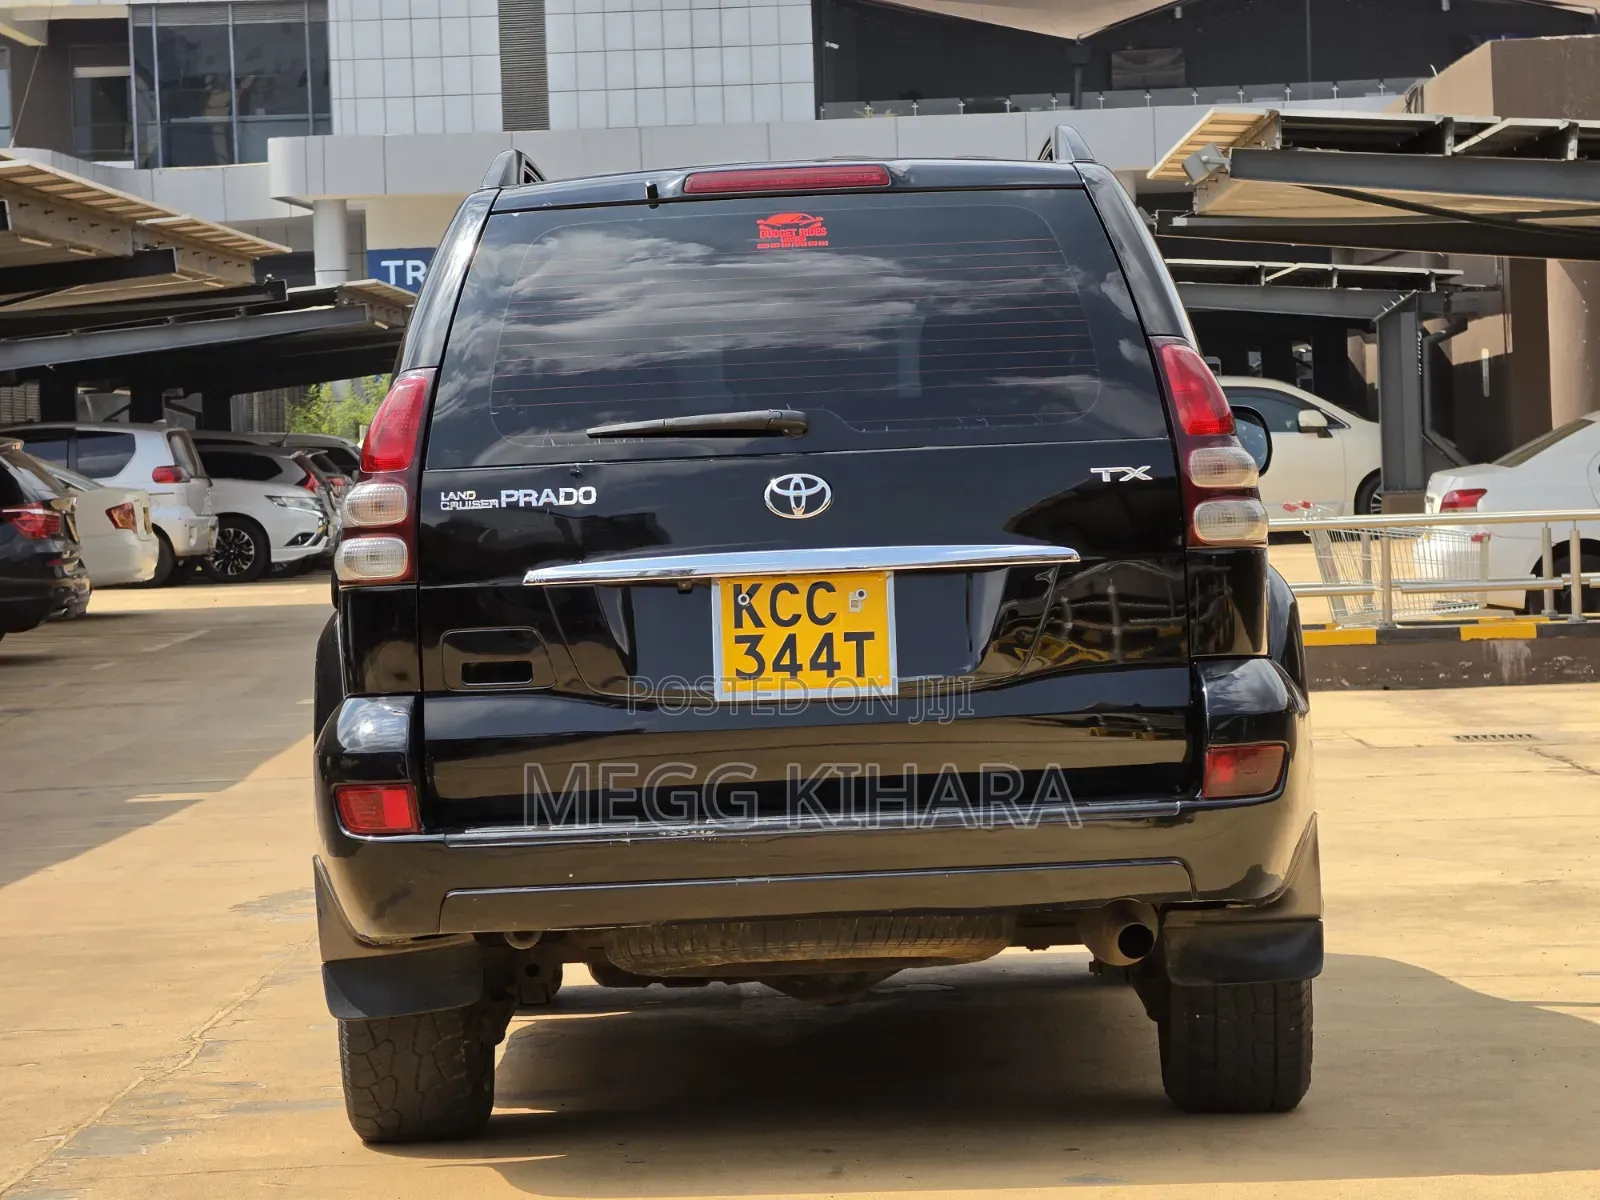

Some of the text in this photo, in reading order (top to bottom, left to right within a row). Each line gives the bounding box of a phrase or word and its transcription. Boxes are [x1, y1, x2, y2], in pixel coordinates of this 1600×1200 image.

[760, 227, 827, 239] BUDGET RIDES
[1090, 465, 1154, 483] TX
[440, 490, 477, 501] LAND
[500, 486, 598, 508] PRADO
[440, 499, 499, 511] CRUISER
[733, 580, 837, 629] KCC
[734, 631, 875, 681] 344T
